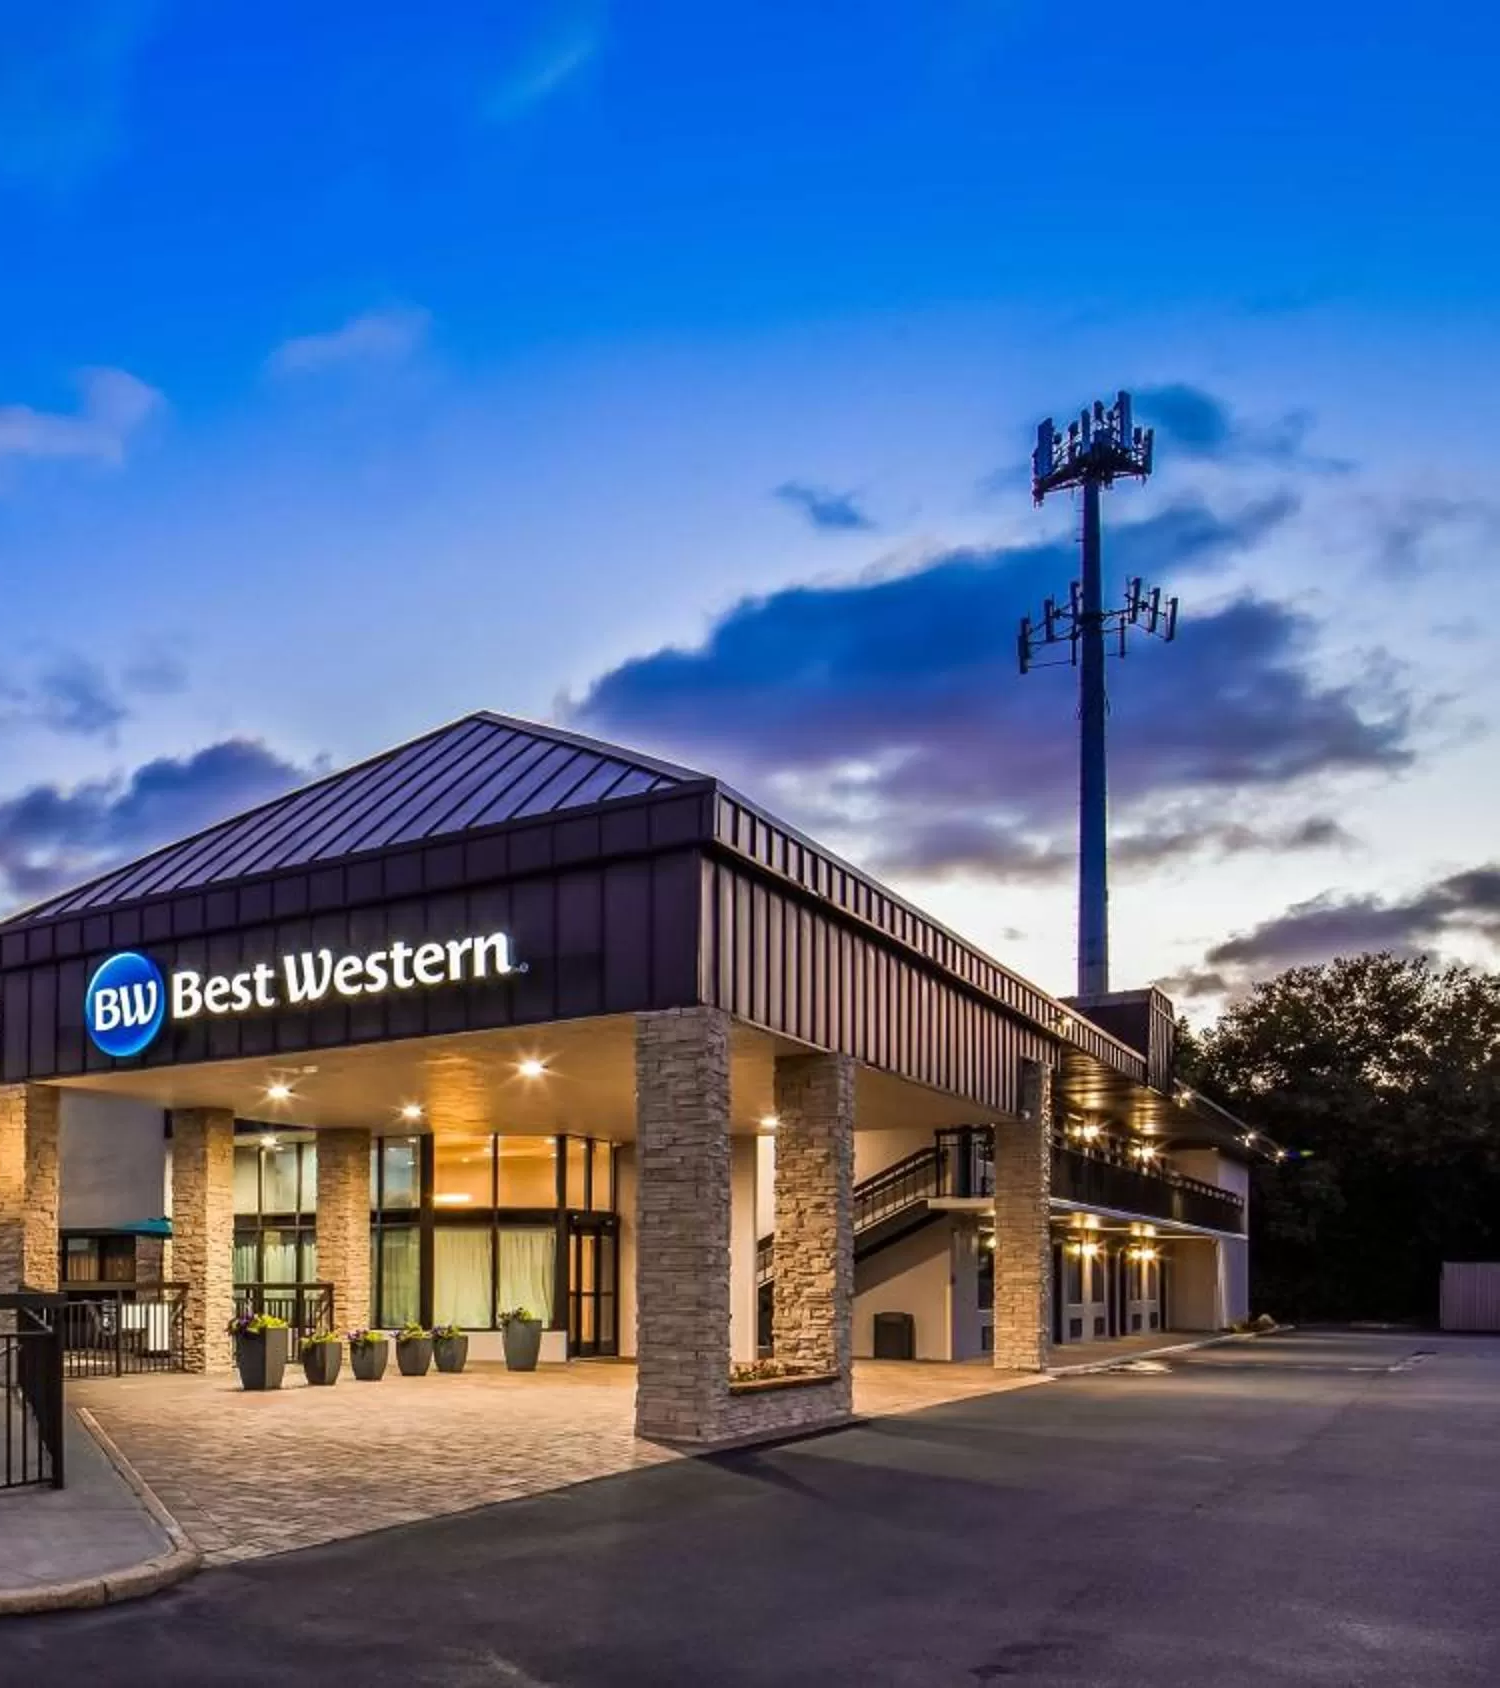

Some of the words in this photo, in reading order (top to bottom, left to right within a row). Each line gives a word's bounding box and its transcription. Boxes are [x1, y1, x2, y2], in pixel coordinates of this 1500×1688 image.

[94, 981, 158, 1031] BW
[172, 962, 276, 1019] Best
[282, 931, 512, 1003] Western
